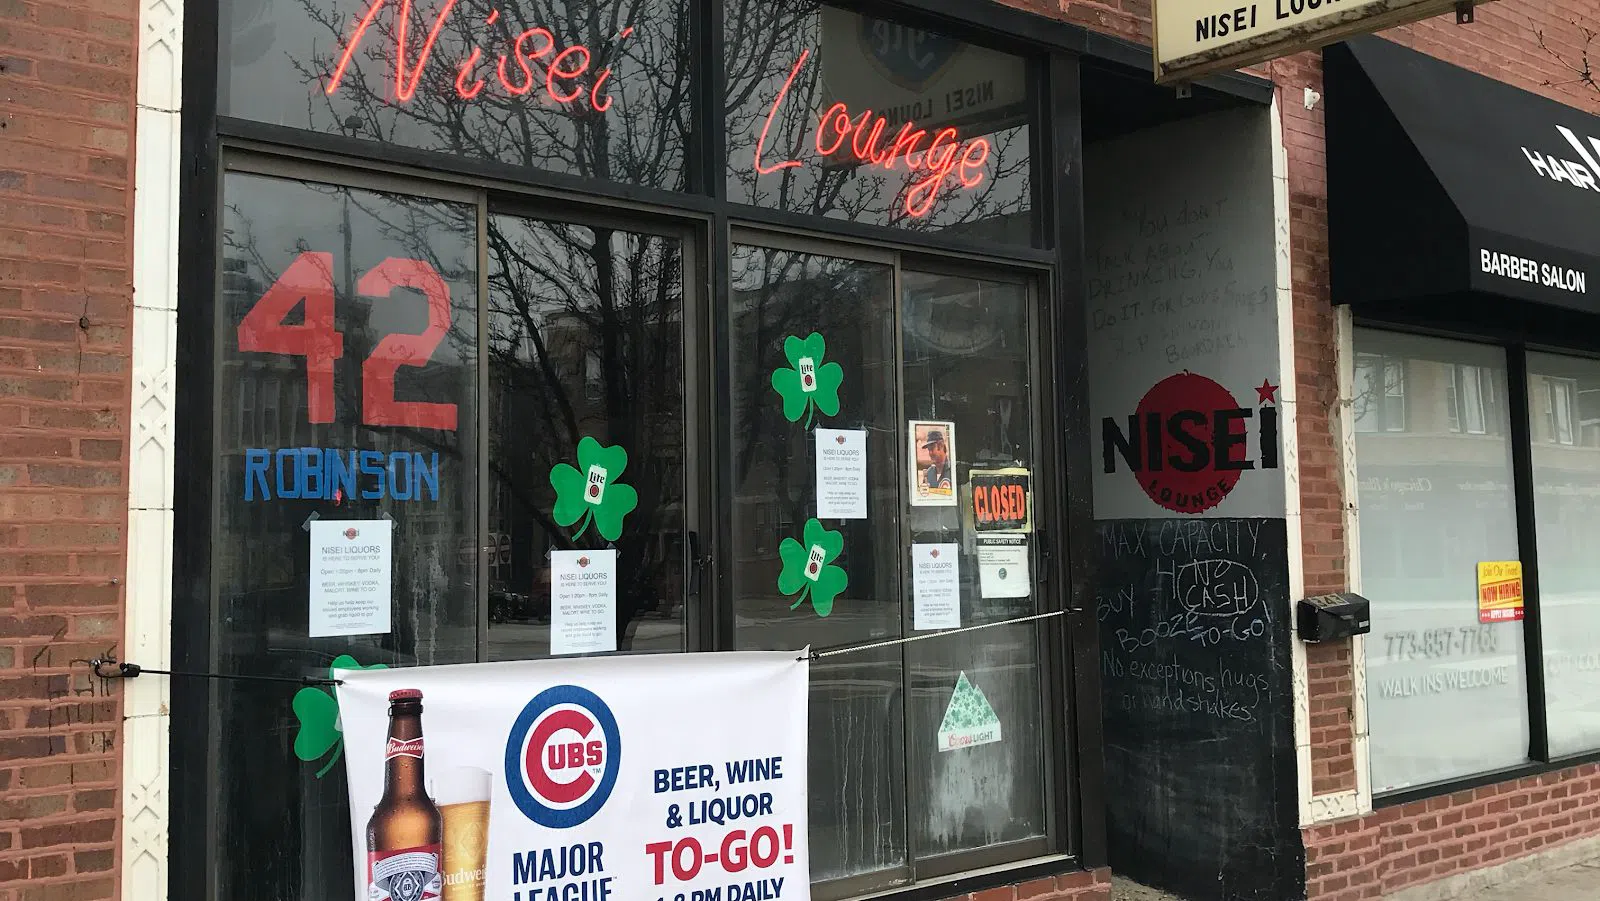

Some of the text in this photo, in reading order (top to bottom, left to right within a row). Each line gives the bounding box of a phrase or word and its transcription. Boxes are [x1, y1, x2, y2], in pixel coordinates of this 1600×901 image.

[1196, 0, 1341, 42] NISEI LO
[326, 0, 634, 112] Nisei
[755, 48, 991, 217] Lounge
[1520, 146, 1600, 193] HAIR
[1481, 248, 1586, 294] BARBER SALON
[237, 251, 458, 432] 42
[244, 447, 440, 501] ROBINSON
[590, 470, 605, 484] Lite
[1149, 479, 1231, 507] LOUNGE
[974, 484, 1025, 522] CLOSED
[322, 545, 381, 555] NISEI LIQUORS
[1101, 521, 1147, 560] MAX
[560, 572, 608, 581] NISEI LIQUORS
[1185, 575, 1248, 615] CASH
[1482, 581, 1521, 603] NOW HIRING
[1096, 583, 1135, 621] BUY
[1115, 610, 1205, 653] BOOZE
[1103, 647, 1125, 679] No
[1380, 665, 1510, 700] WALK INS WELCOME
[973, 731, 994, 743] LIGHT
[654, 756, 783, 794] BEER, WINE
[666, 792, 773, 829] & LIQUOR
[513, 841, 604, 885] MAJOR
[646, 823, 795, 885] TO-GO!
[727, 877, 785, 901] DAILY
